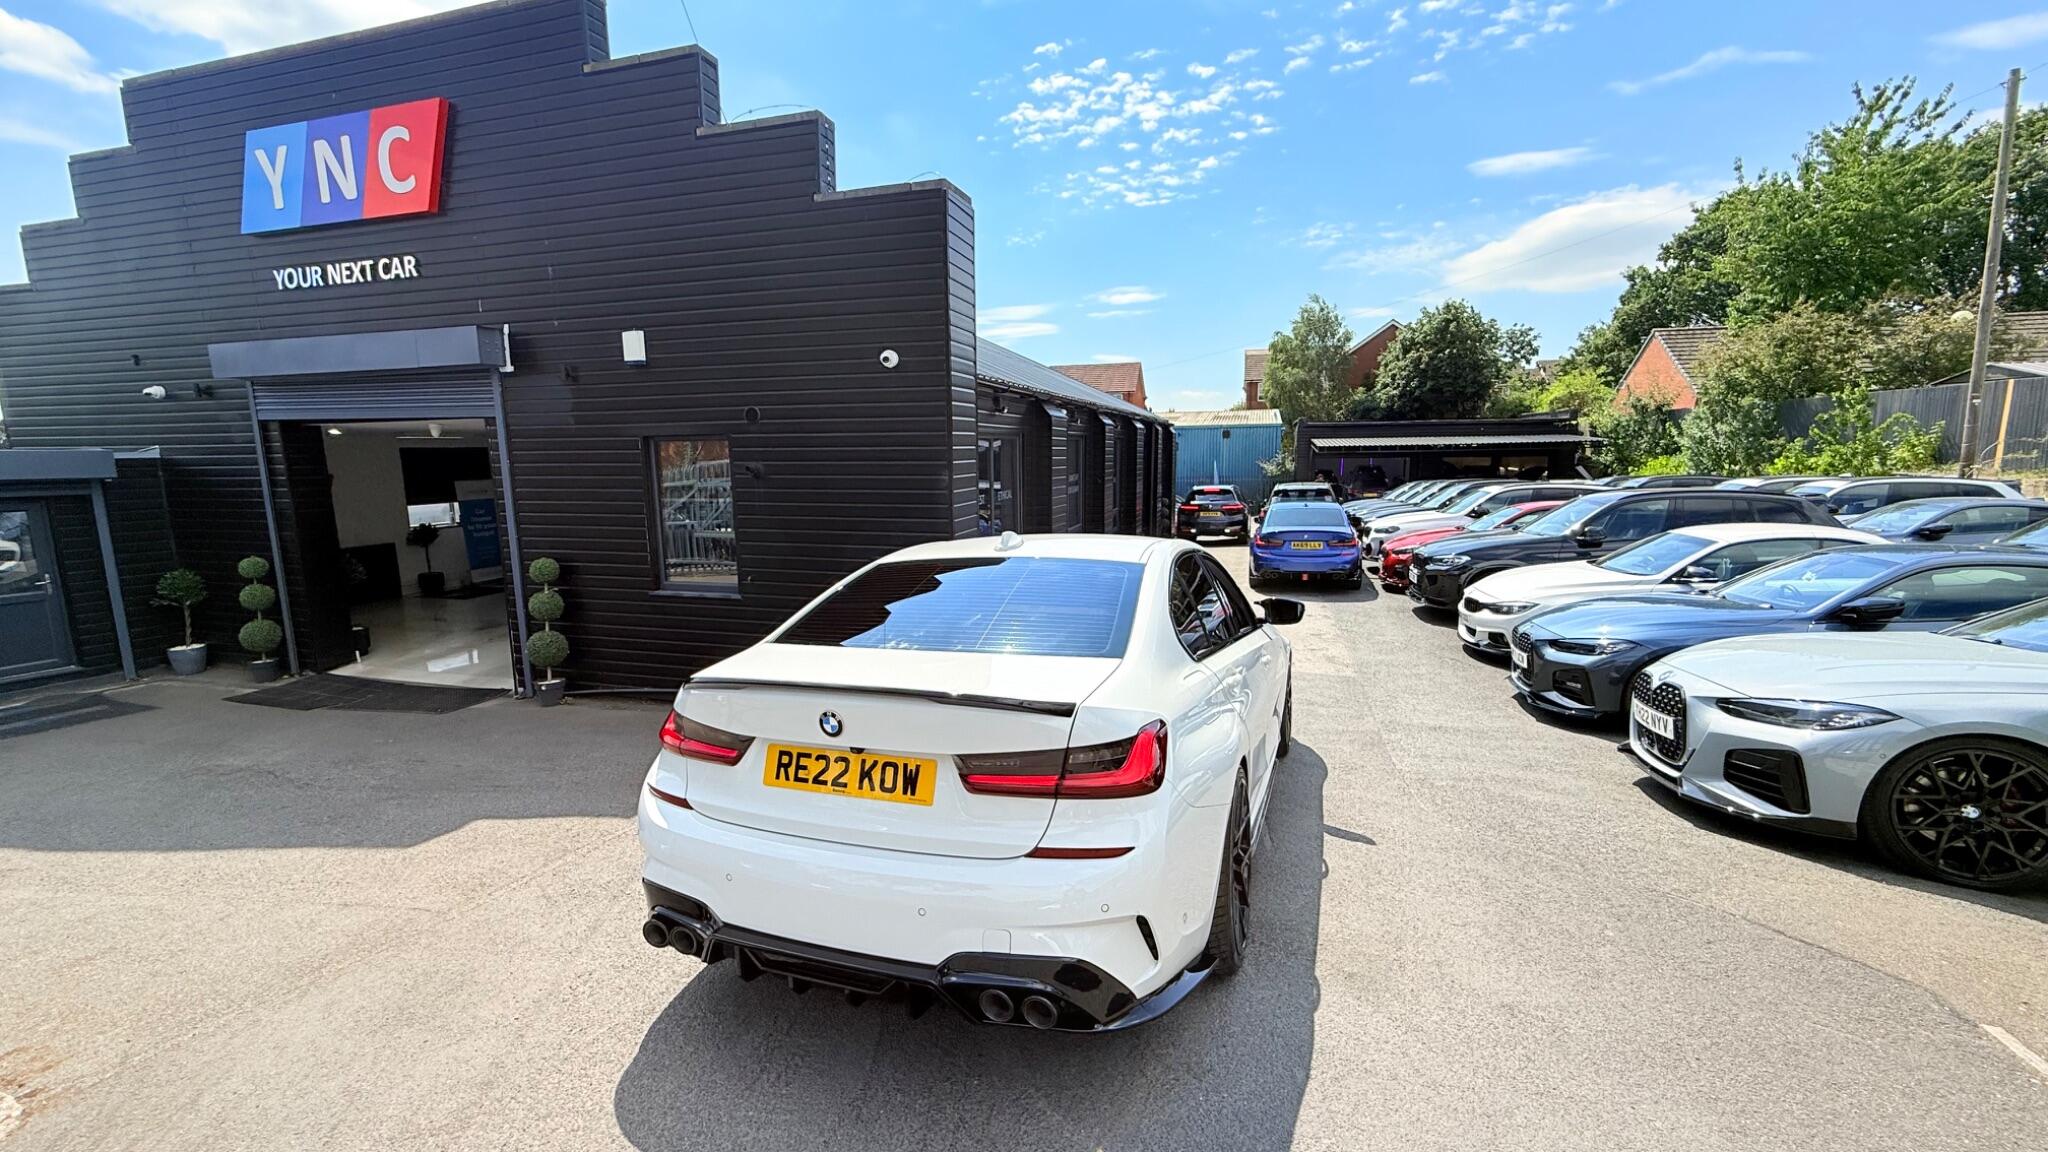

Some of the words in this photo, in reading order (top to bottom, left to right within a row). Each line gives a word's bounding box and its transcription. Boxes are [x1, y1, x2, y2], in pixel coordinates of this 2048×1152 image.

[254, 125, 416, 209] YNC
[273, 267, 324, 289] YOUR
[327, 260, 373, 284] NEXT
[378, 255, 418, 279] CAR
[775, 750, 850, 788] RE22
[858, 759, 921, 796] KOW
